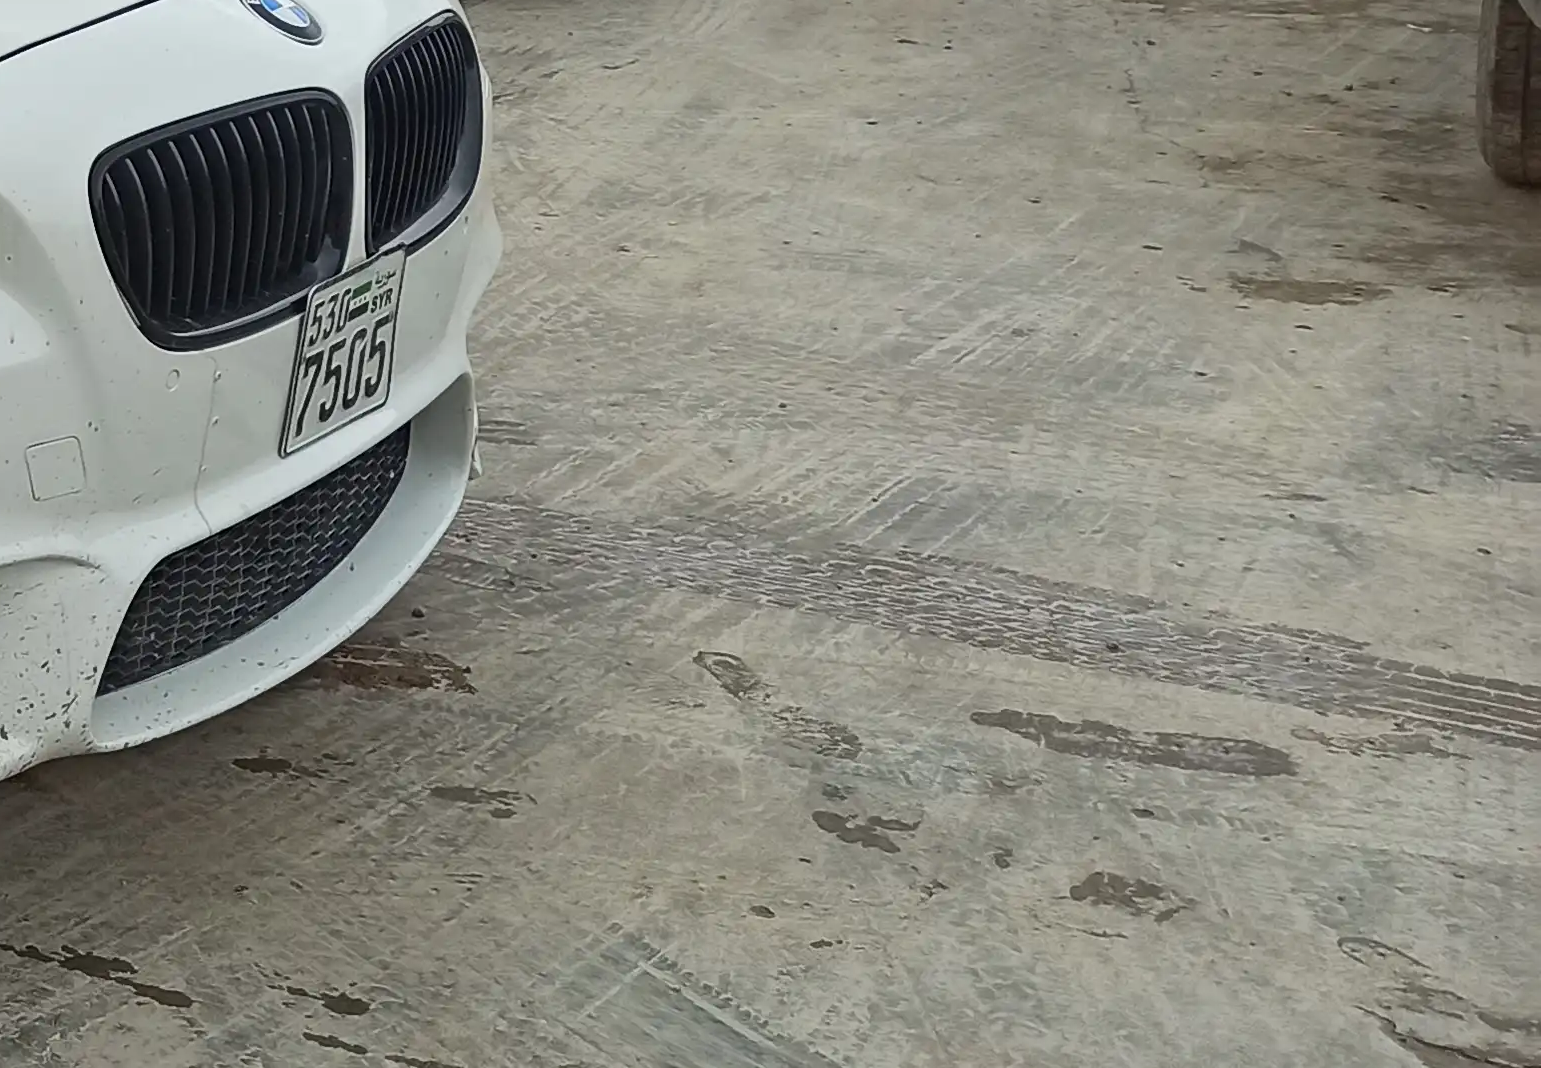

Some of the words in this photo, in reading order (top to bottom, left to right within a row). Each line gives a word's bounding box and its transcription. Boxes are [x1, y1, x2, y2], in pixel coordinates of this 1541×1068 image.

[308, 287, 352, 347] 530
[370, 287, 394, 314] SYR
[295, 313, 392, 438] 7505
